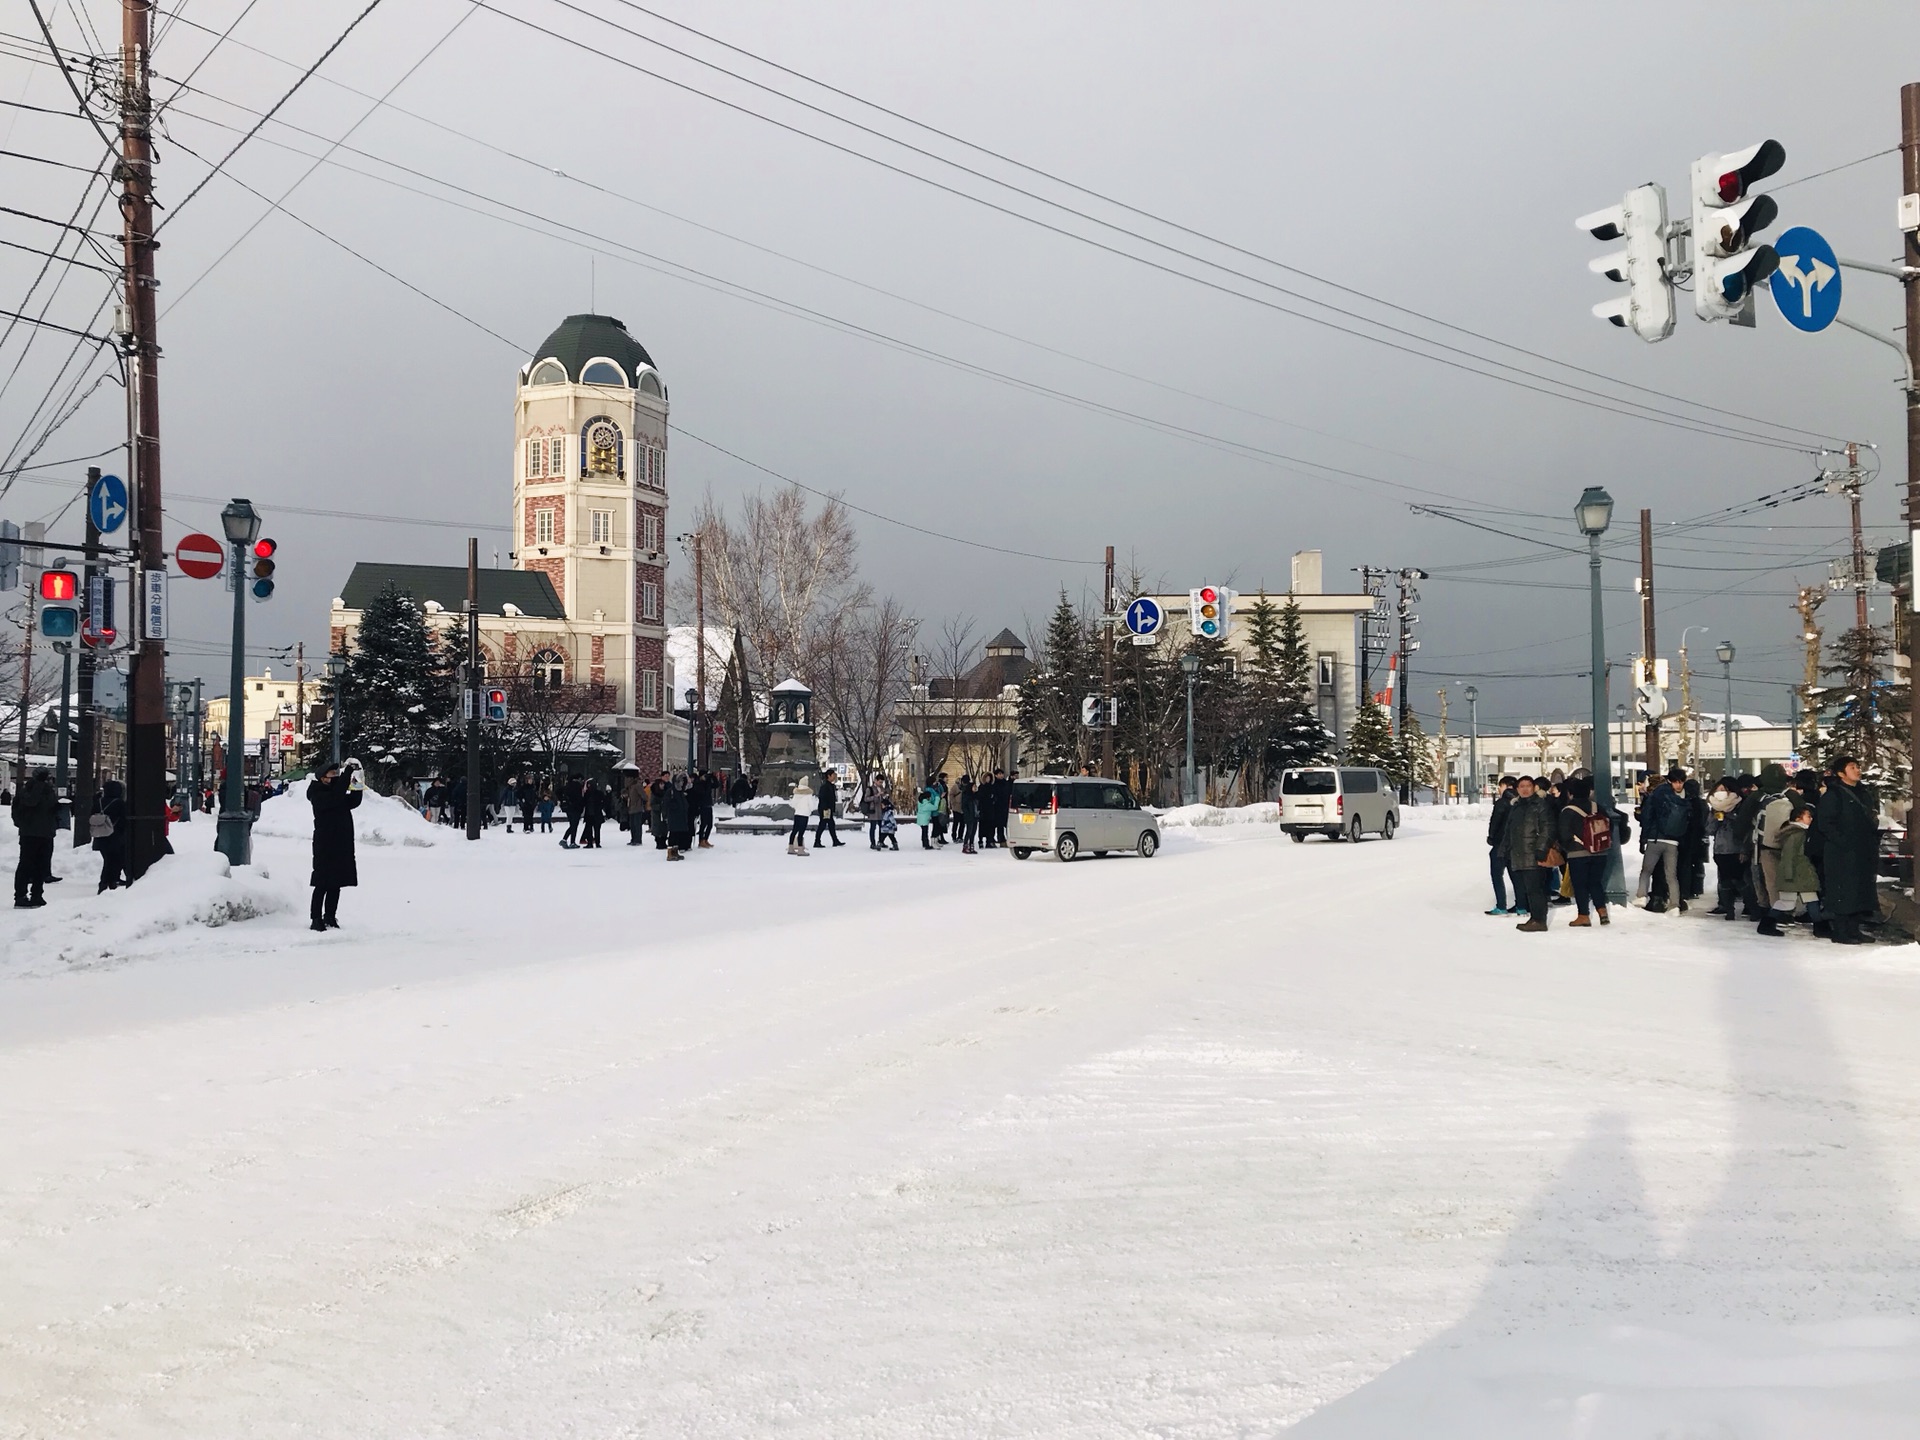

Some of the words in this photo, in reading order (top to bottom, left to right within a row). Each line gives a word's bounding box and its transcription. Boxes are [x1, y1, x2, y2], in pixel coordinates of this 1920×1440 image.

[151, 572, 162, 637] 歩車分離信号
[281, 719, 295, 747] 地酒
